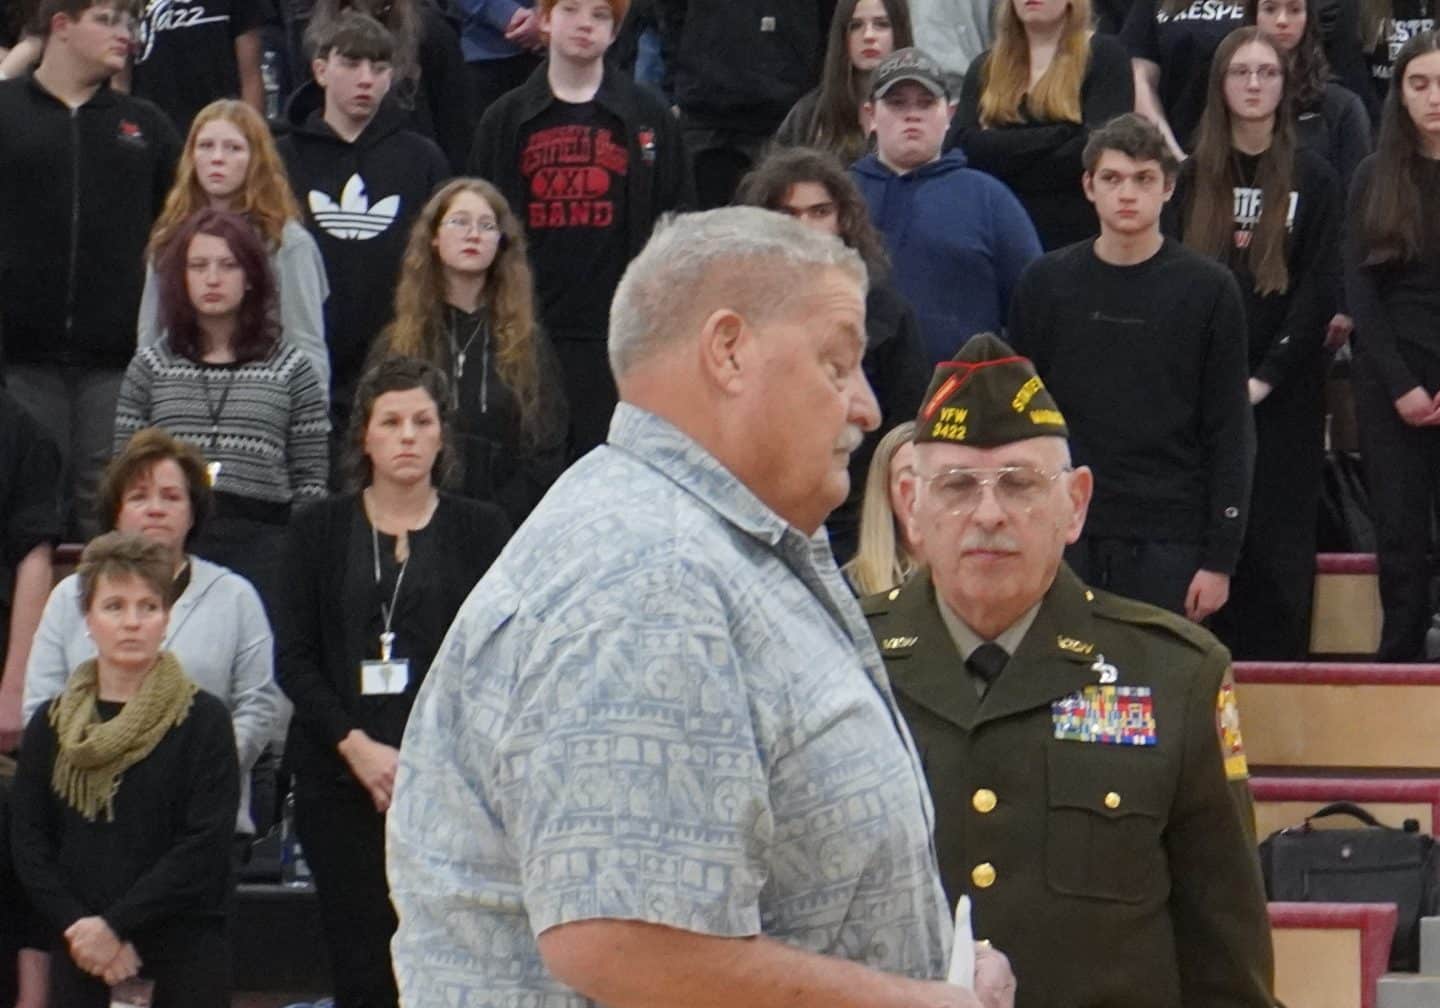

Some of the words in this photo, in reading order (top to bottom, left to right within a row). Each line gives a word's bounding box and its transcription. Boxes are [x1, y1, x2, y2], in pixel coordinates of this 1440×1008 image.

[540, 169, 601, 197] XXL
[529, 201, 614, 228] BAND
[941, 407, 968, 423] VFW
